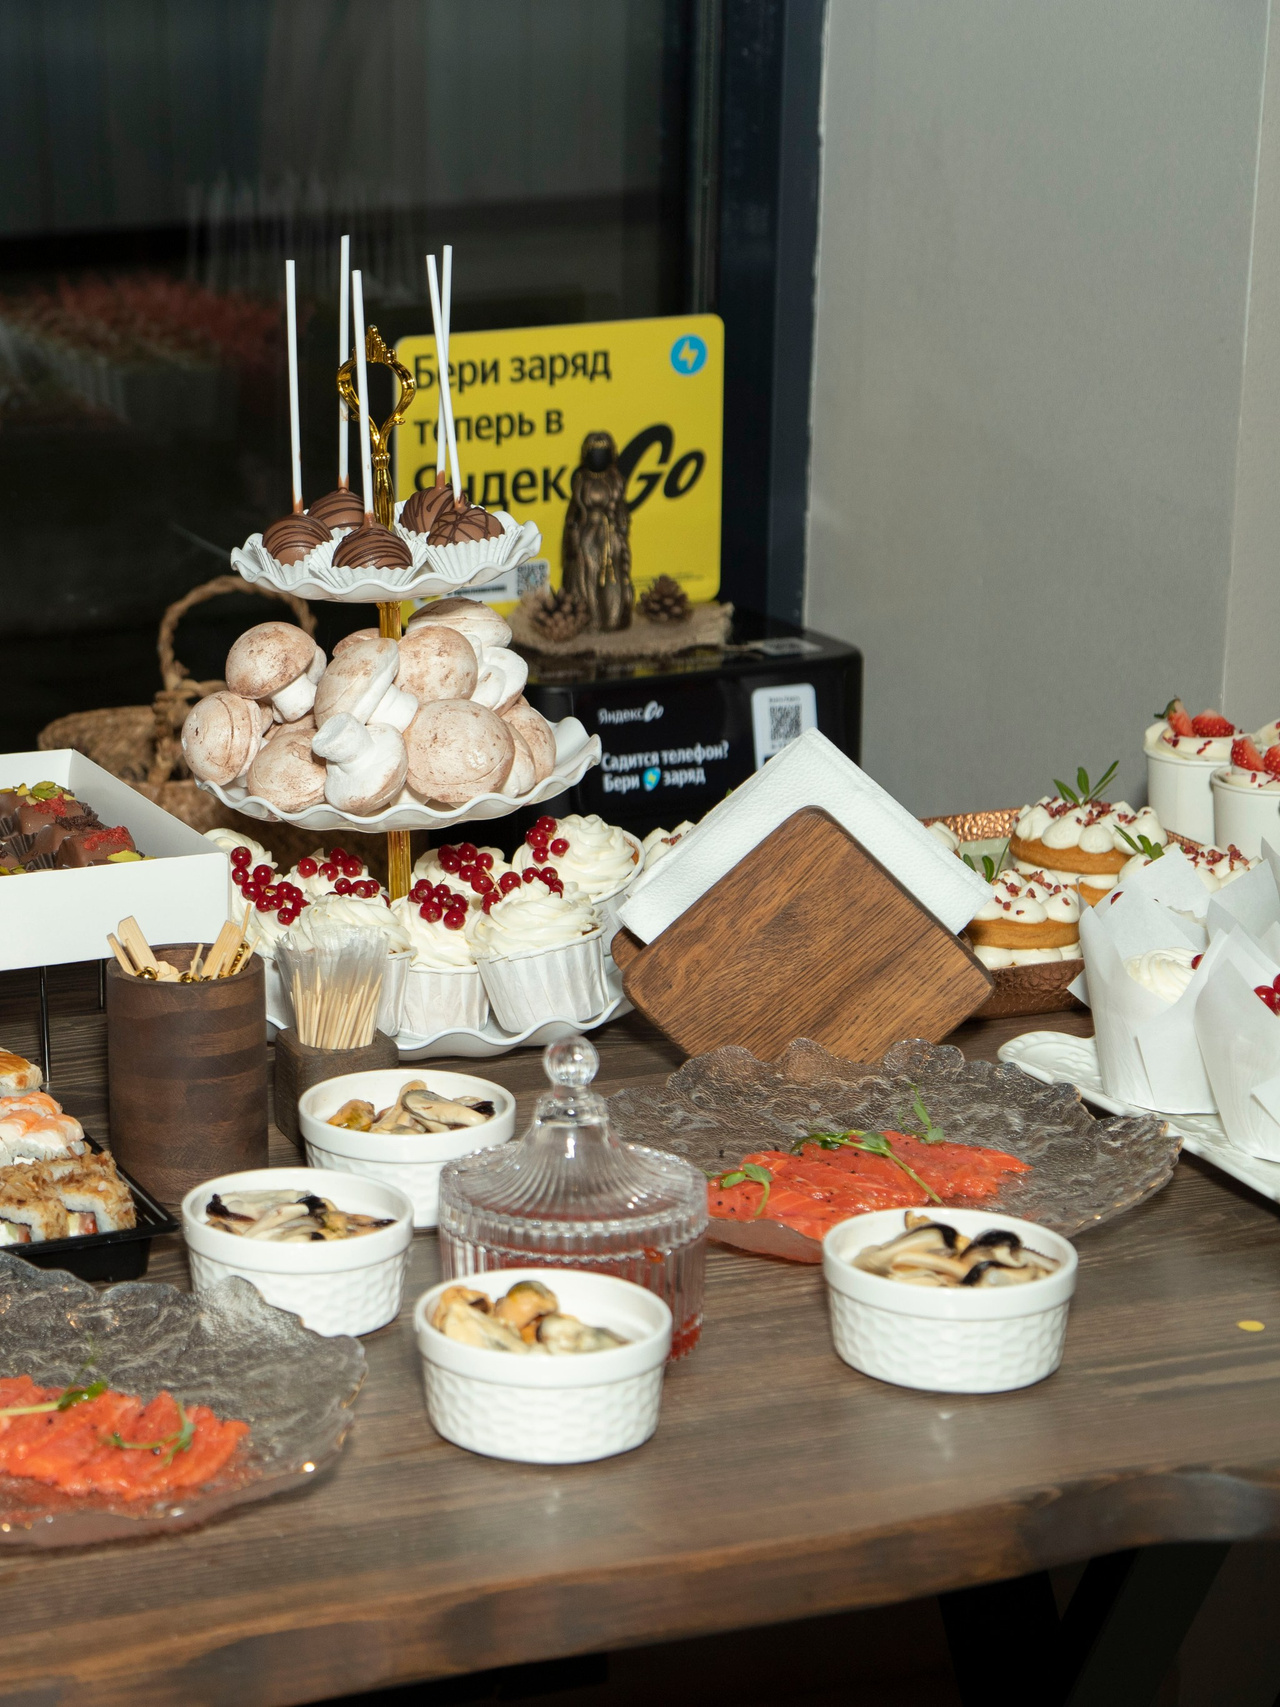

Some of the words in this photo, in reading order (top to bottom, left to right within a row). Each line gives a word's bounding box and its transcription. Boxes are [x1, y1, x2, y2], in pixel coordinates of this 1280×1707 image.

[509, 350, 611, 387] заряд
[545, 409, 564, 435] в
[414, 463, 574, 513] ндек
[617, 422, 707, 514] Go
[598, 707, 644, 725] Яндекс
[601, 751, 660, 773] Садится
[660, 740, 729, 766] телефон?
[603, 773, 640, 794] Бери
[663, 767, 706, 788] заряд
